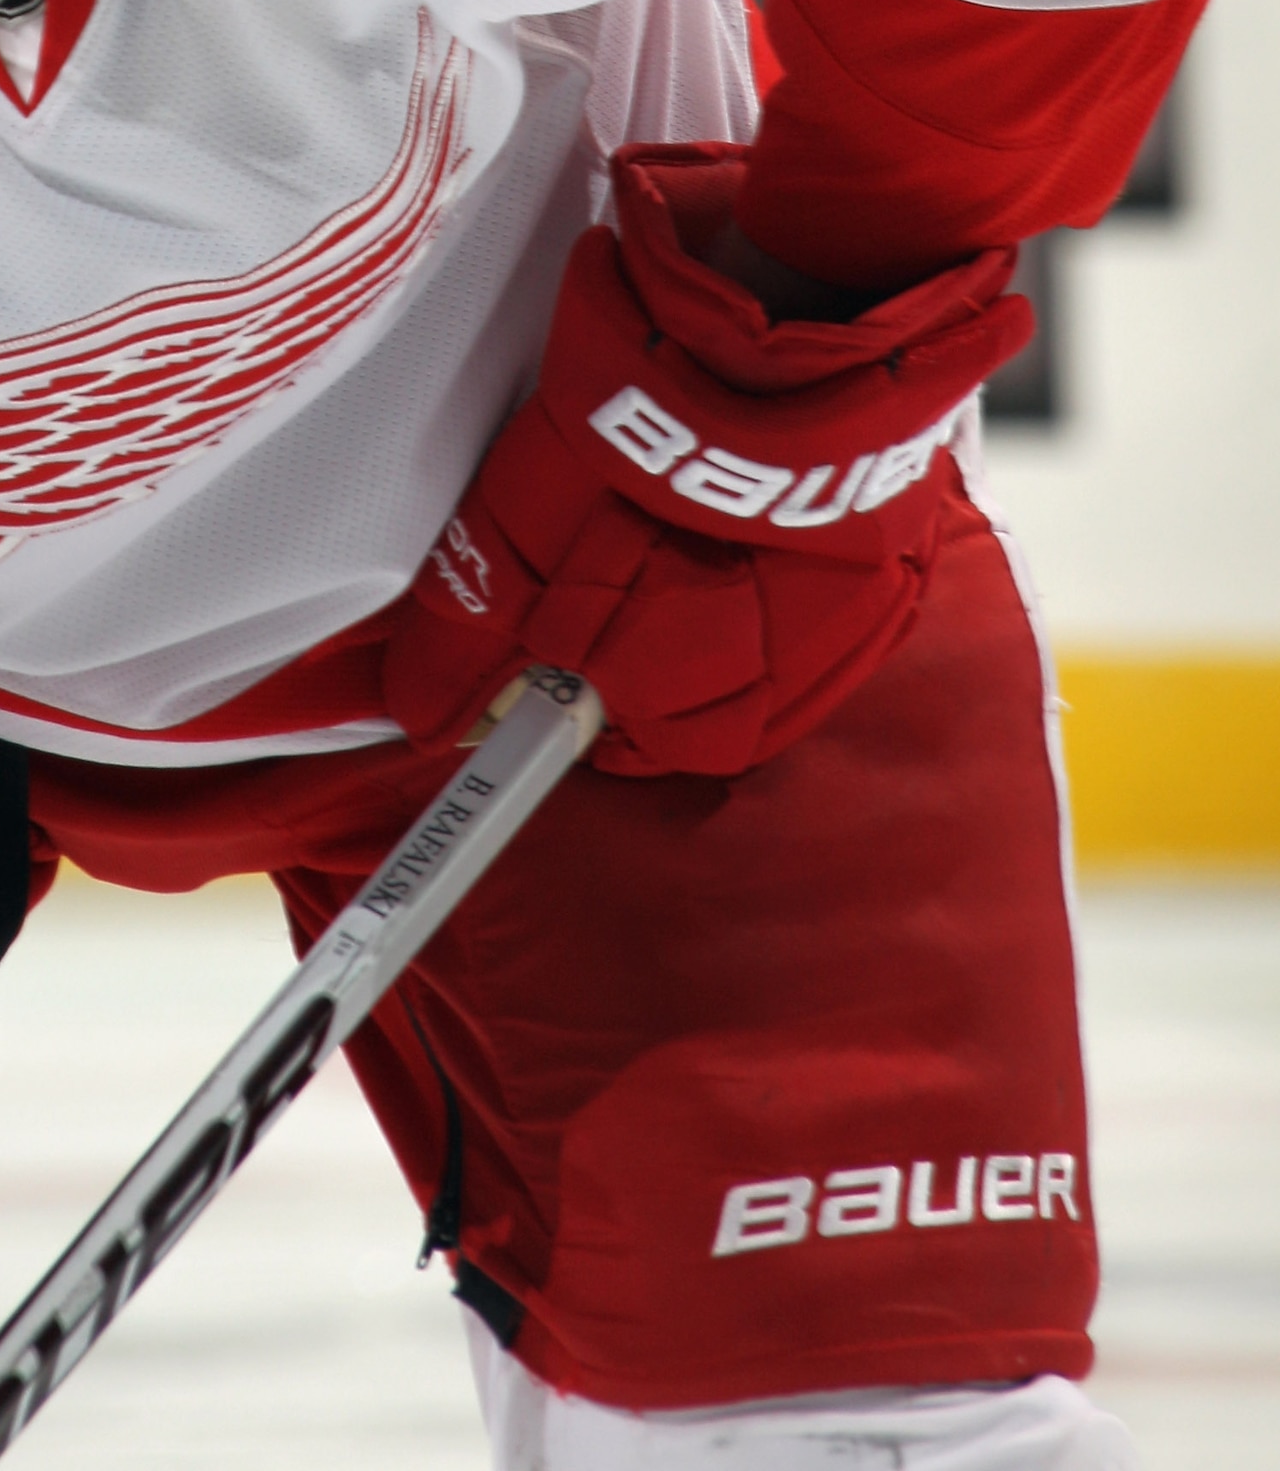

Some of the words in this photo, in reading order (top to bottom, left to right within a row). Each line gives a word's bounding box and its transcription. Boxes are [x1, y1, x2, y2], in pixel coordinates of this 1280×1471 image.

[457, 774, 496, 797] B.
[361, 801, 472, 920] RAFALSKI
[711, 1152, 1080, 1259] BAUER
